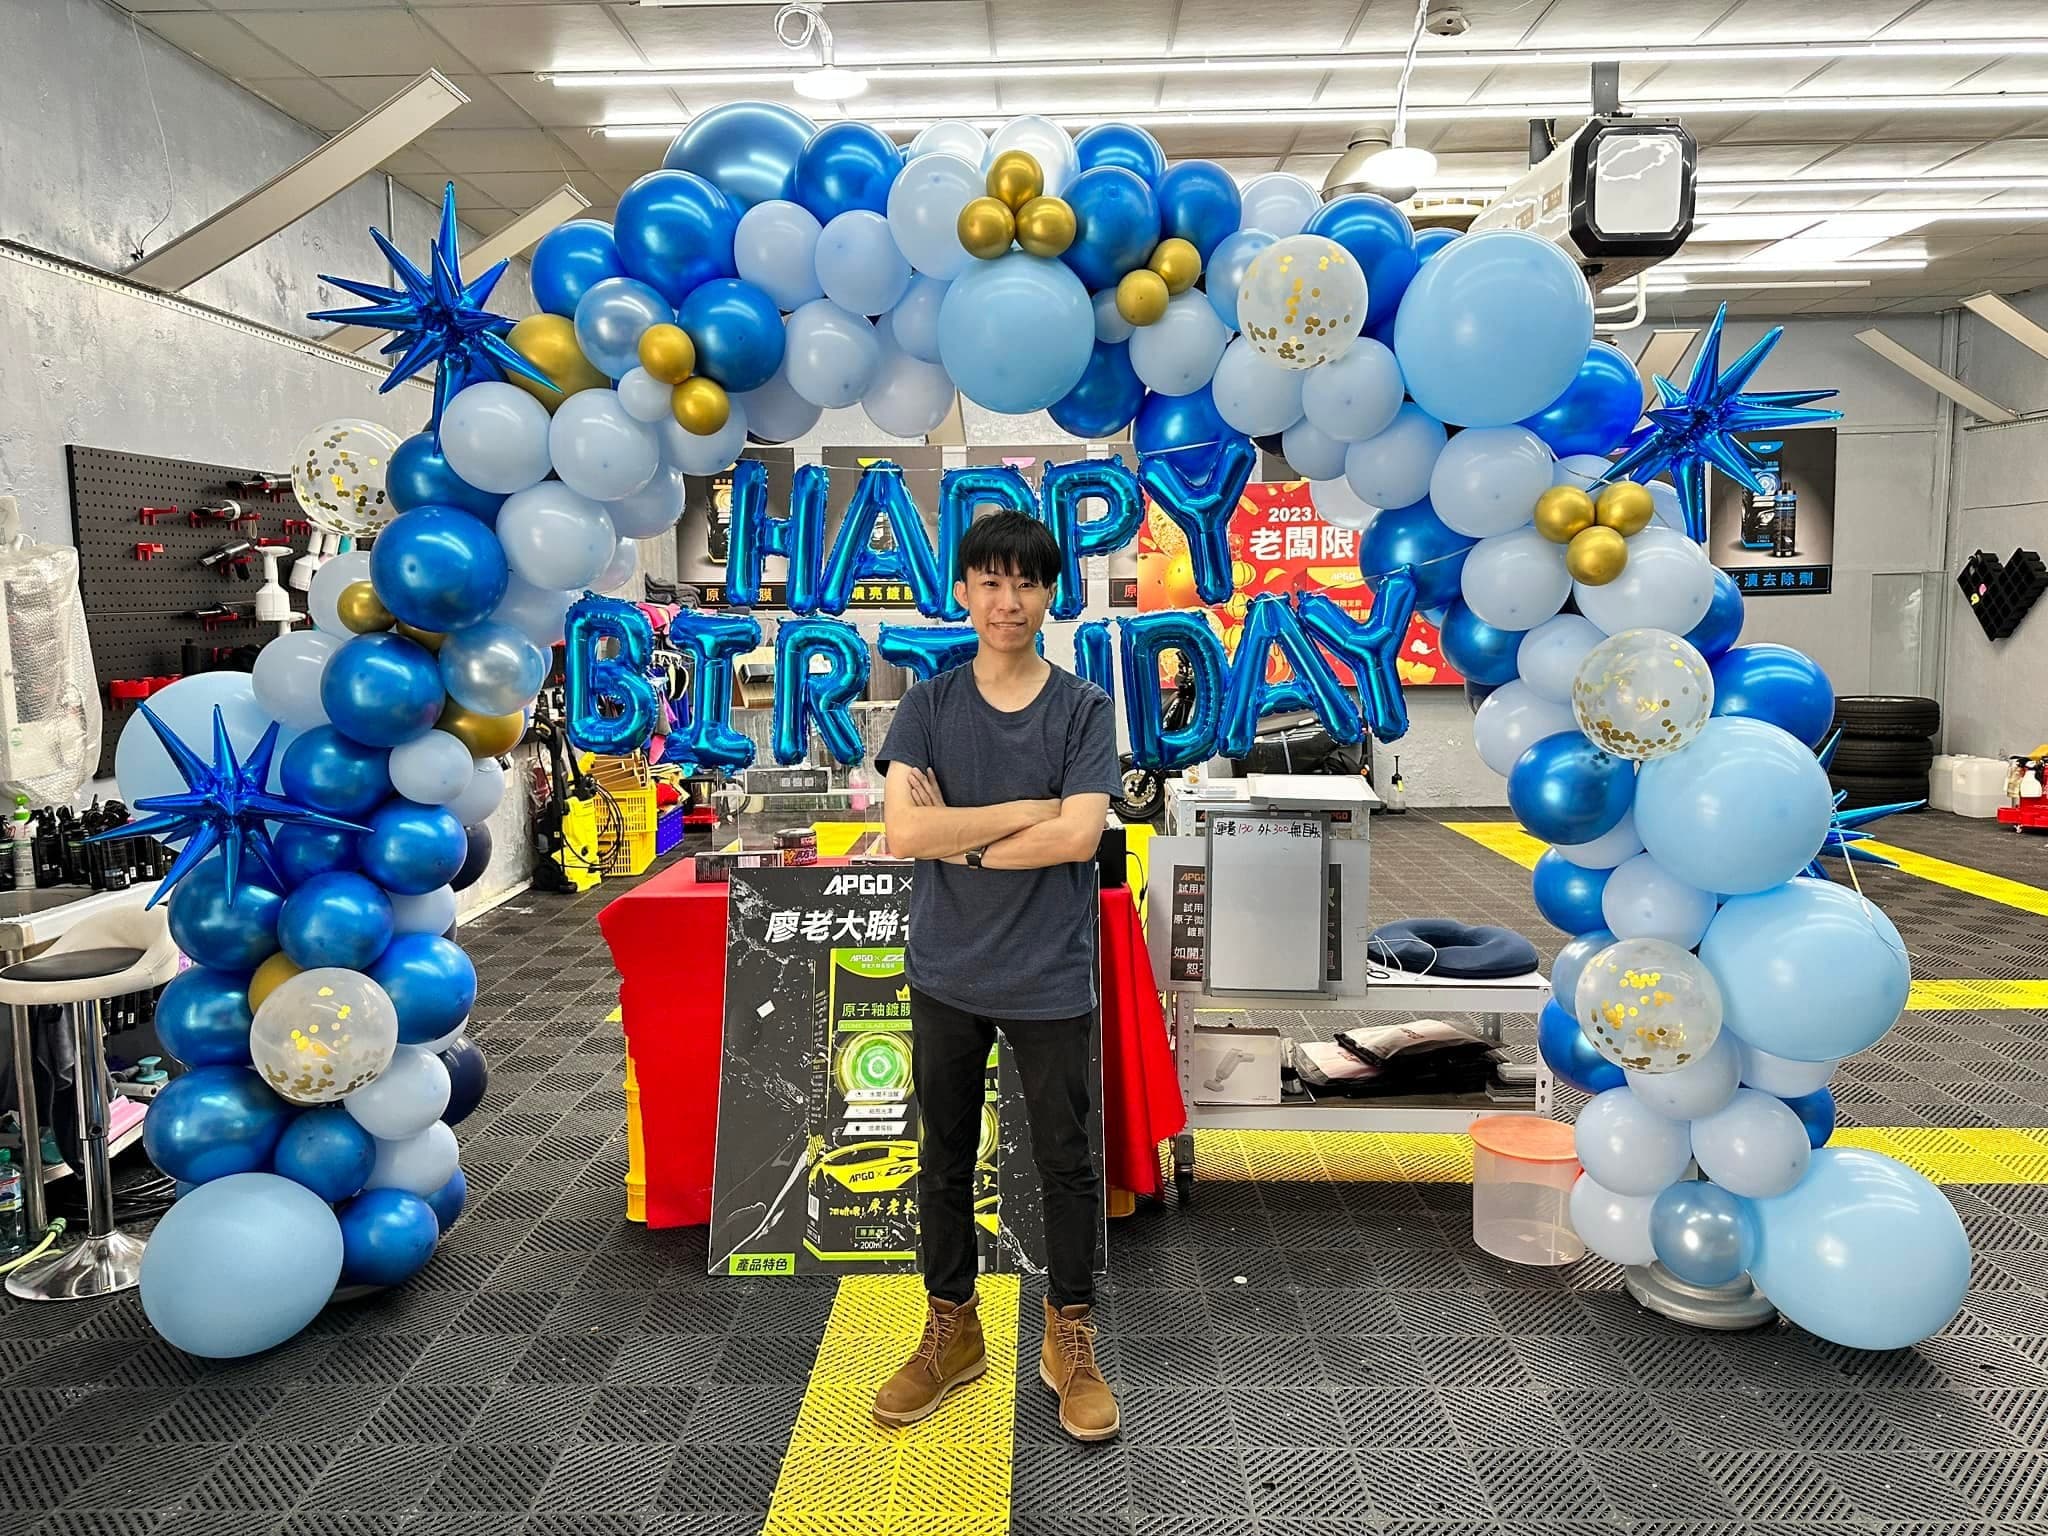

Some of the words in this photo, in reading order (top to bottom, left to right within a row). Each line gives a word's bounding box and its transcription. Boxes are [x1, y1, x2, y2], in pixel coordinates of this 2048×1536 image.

[1268, 506, 1312, 522] 2023
[727, 438, 1256, 621] HAPPY
[1249, 526, 1363, 560] 老闆限
[705, 588, 772, 602] 原膜
[823, 874, 893, 895] APGO
[849, 1171, 874, 1183] APGO
[860, 1241, 883, 1249] 200ml
[736, 1258, 788, 1271] 產品特色
